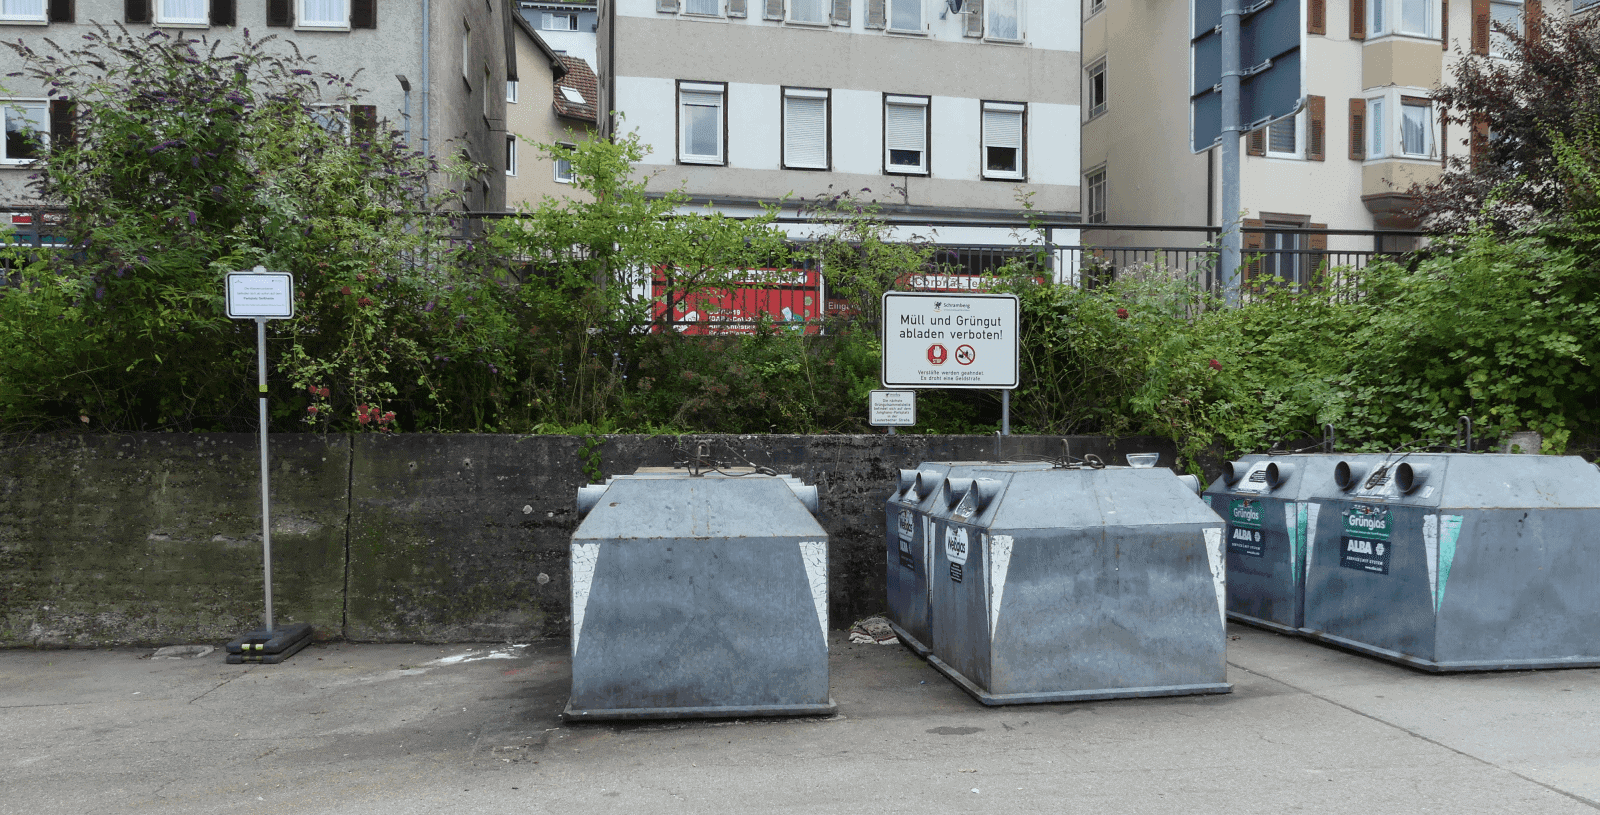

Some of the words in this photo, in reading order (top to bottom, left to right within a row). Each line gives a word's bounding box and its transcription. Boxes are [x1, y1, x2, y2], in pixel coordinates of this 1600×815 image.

[828, 301, 861, 312] Eing
[900, 314, 925, 326] Müll
[930, 315, 951, 326] und
[956, 315, 1002, 329] Grüngut
[899, 328, 945, 339] abladen
[949, 330, 1003, 340] verboten!
[1233, 507, 1260, 522] Grünglas
[1348, 514, 1386, 531] Grünglas
[1232, 528, 1253, 542] ALBA
[947, 536, 966, 556] Weißglas
[1347, 539, 1373, 555] ALBA
